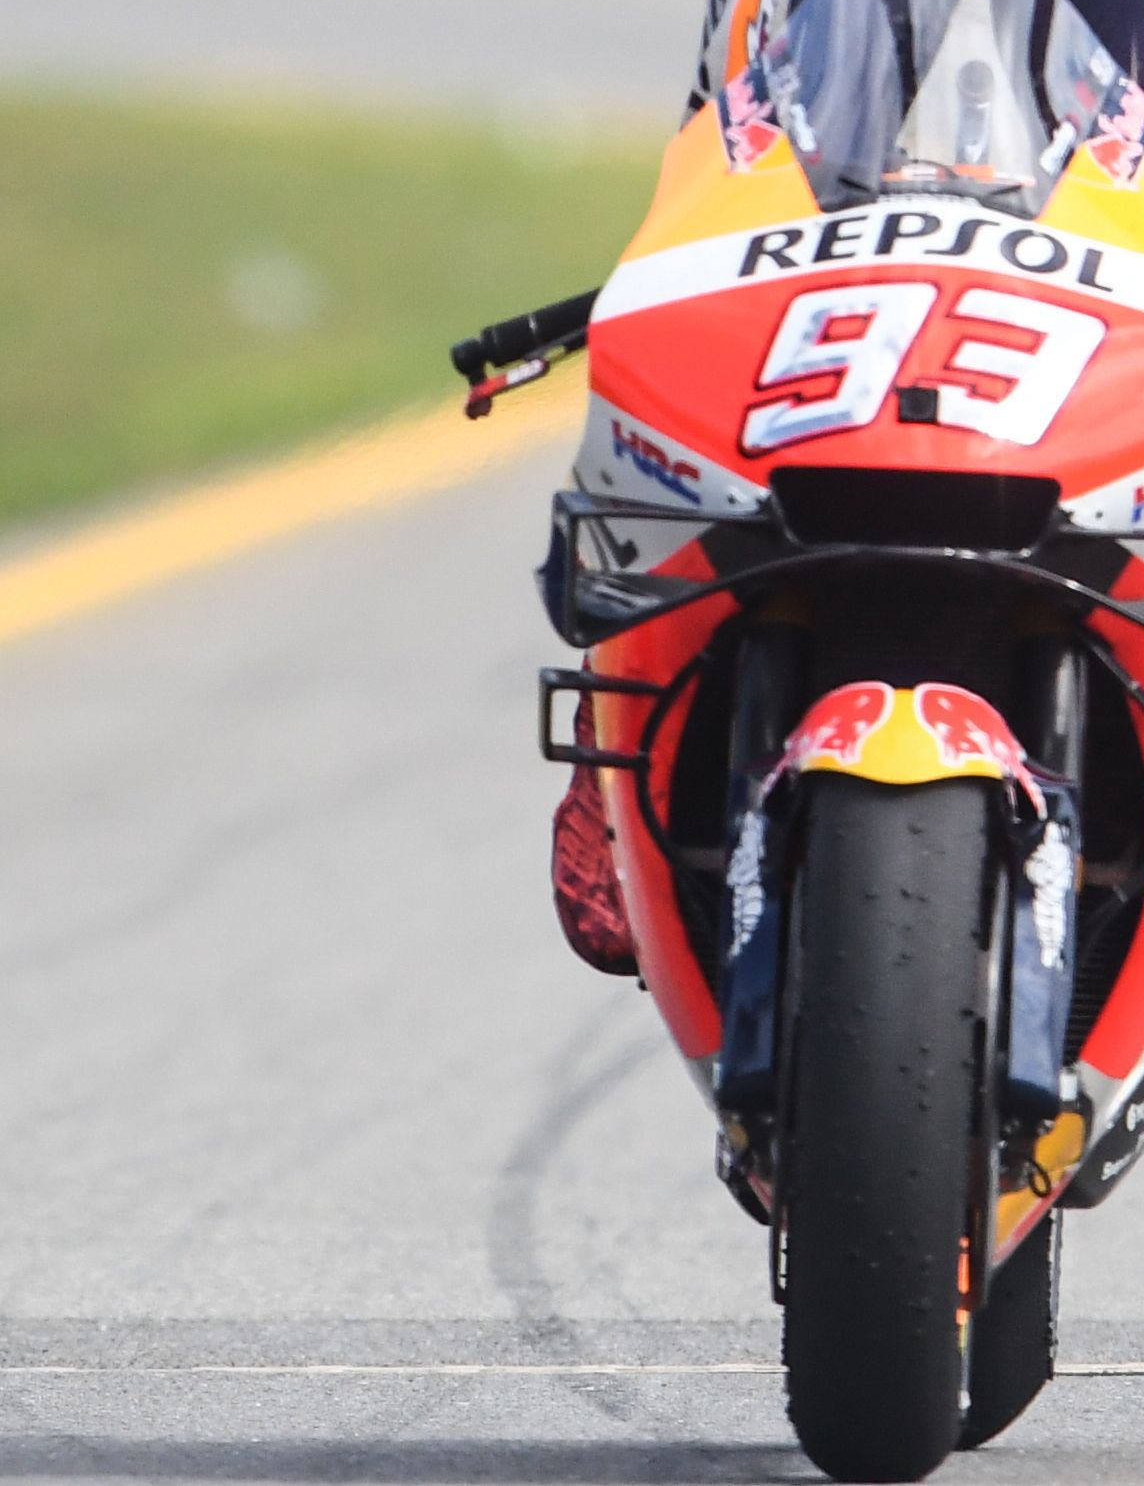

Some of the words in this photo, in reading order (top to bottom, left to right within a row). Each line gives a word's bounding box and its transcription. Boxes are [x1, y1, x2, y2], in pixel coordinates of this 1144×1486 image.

[738, 211, 1114, 292] REPSOL
[739, 280, 1109, 457] 93
[611, 418, 702, 504] HRC
